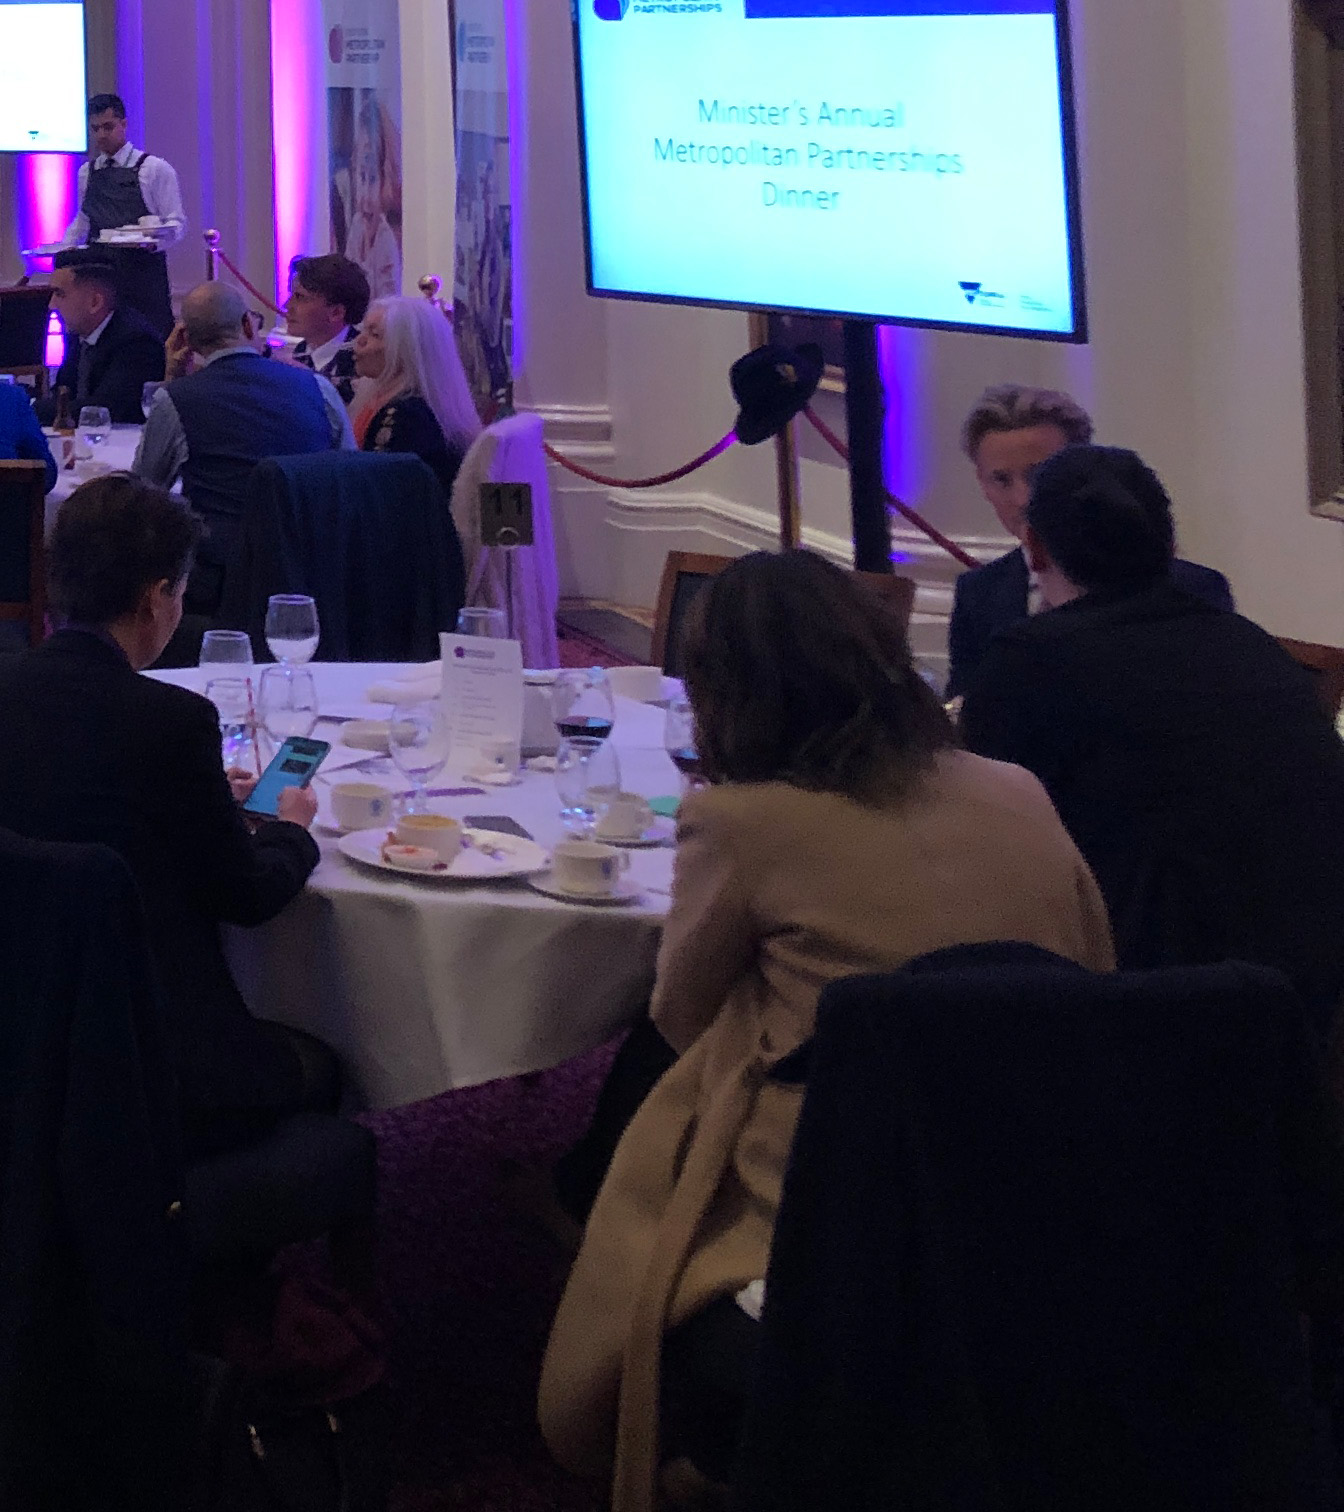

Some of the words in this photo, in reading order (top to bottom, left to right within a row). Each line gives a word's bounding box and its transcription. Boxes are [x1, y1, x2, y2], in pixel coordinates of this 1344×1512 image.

[633, 3, 723, 14] PARTNERSHIPS
[698, 99, 810, 126] Minister's
[817, 101, 905, 129] Annual
[653, 137, 798, 169] Metropolitan
[807, 142, 965, 178] Partnerships
[762, 181, 841, 211] Dinner
[490, 489, 523, 515] 11
